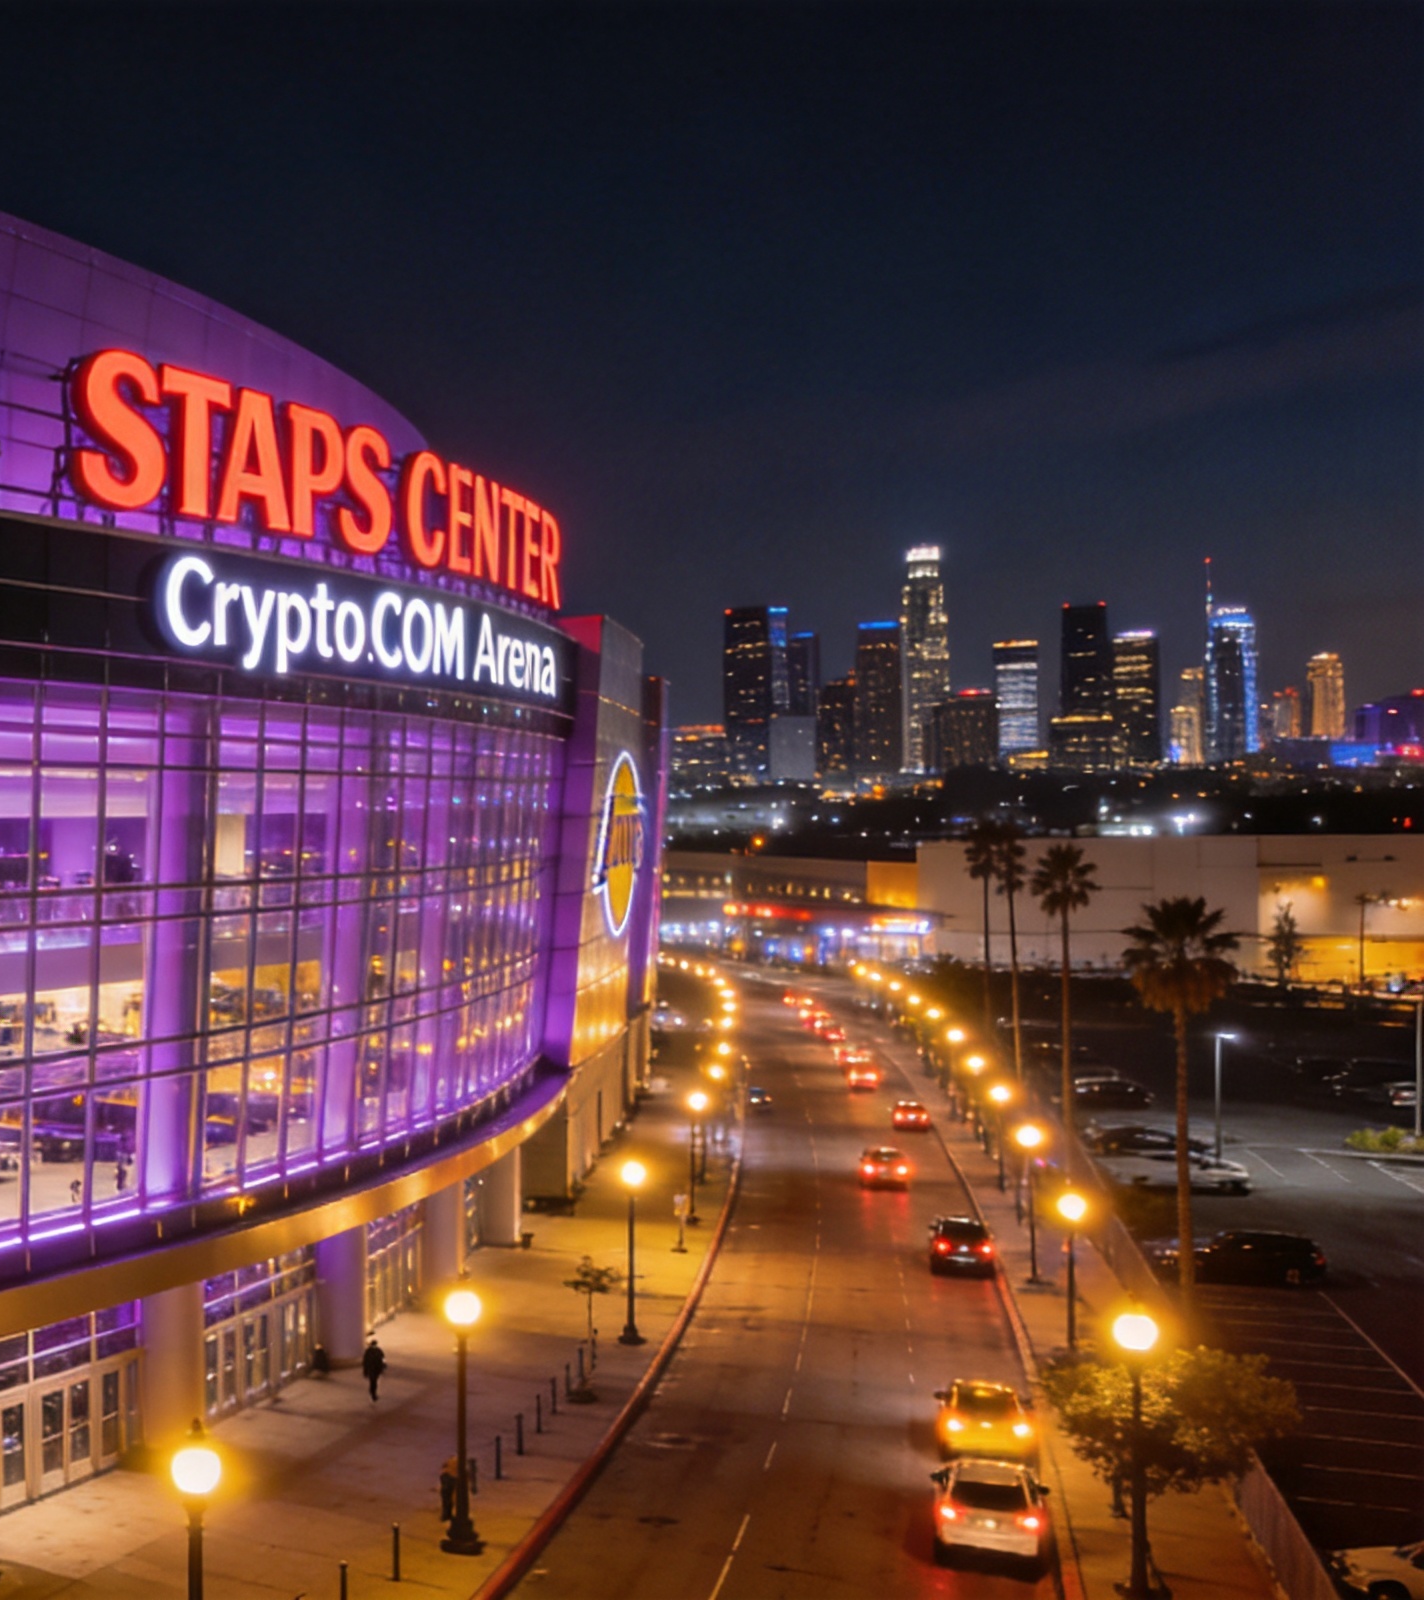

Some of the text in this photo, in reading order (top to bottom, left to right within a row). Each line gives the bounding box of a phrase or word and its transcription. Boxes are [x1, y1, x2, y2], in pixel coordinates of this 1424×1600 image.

[75, 348, 561, 609] STAPS CENTER
[164, 556, 557, 698] Crypto.COM Arena
